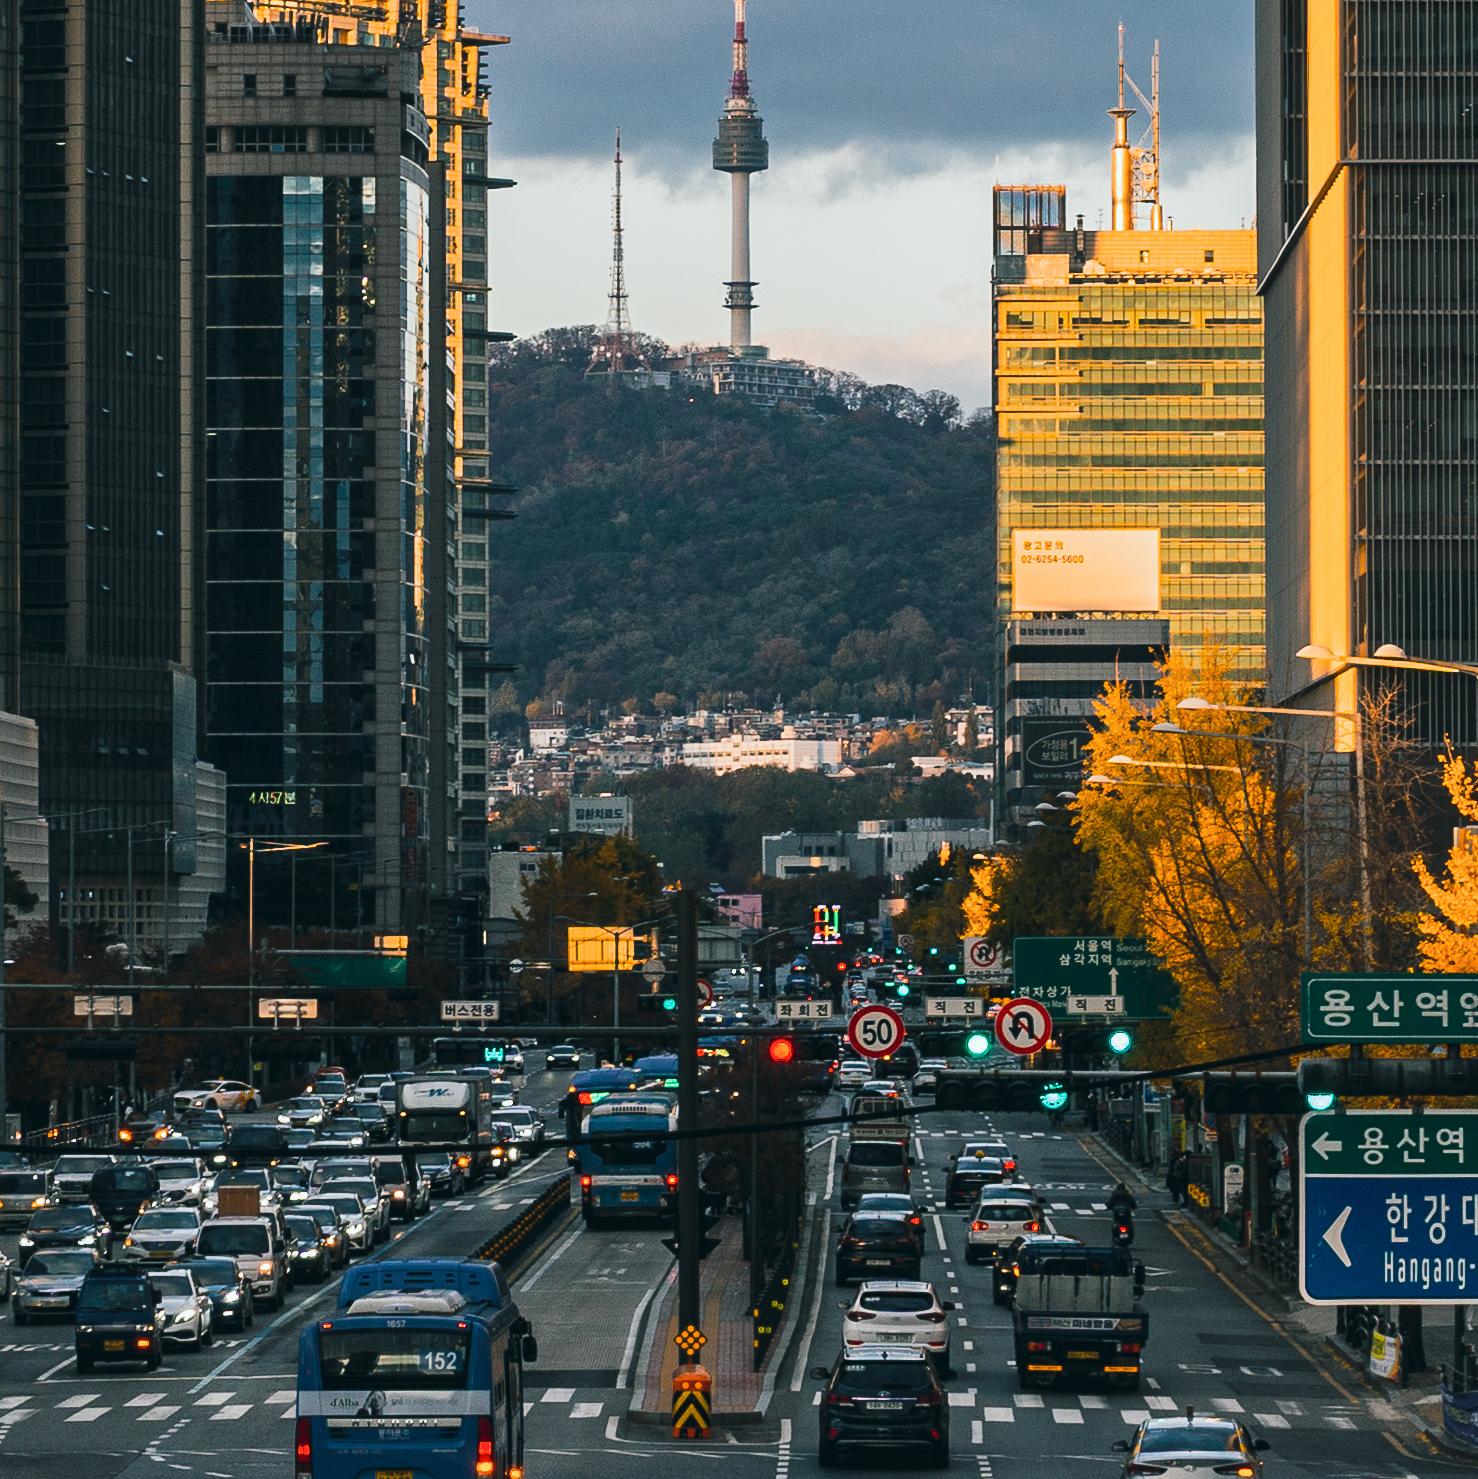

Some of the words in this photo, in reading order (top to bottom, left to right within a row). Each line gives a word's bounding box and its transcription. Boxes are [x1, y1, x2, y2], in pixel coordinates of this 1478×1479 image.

[1023, 540, 1064, 551] 광고문의
[1041, 751, 1068, 761] 보일러
[1074, 940, 1112, 952] 서울역
[1116, 943, 1143, 952] Seoul
[1059, 954, 1112, 966] 삼각지역
[1018, 985, 1072, 999] 전자상가
[444, 1004, 495, 1017] 버스전용
[780, 1004, 828, 1017] 좌회전
[862, 1018, 892, 1045] 50
[1357, 1127, 1464, 1165] 용산역
[424, 1351, 457, 1370] 152
